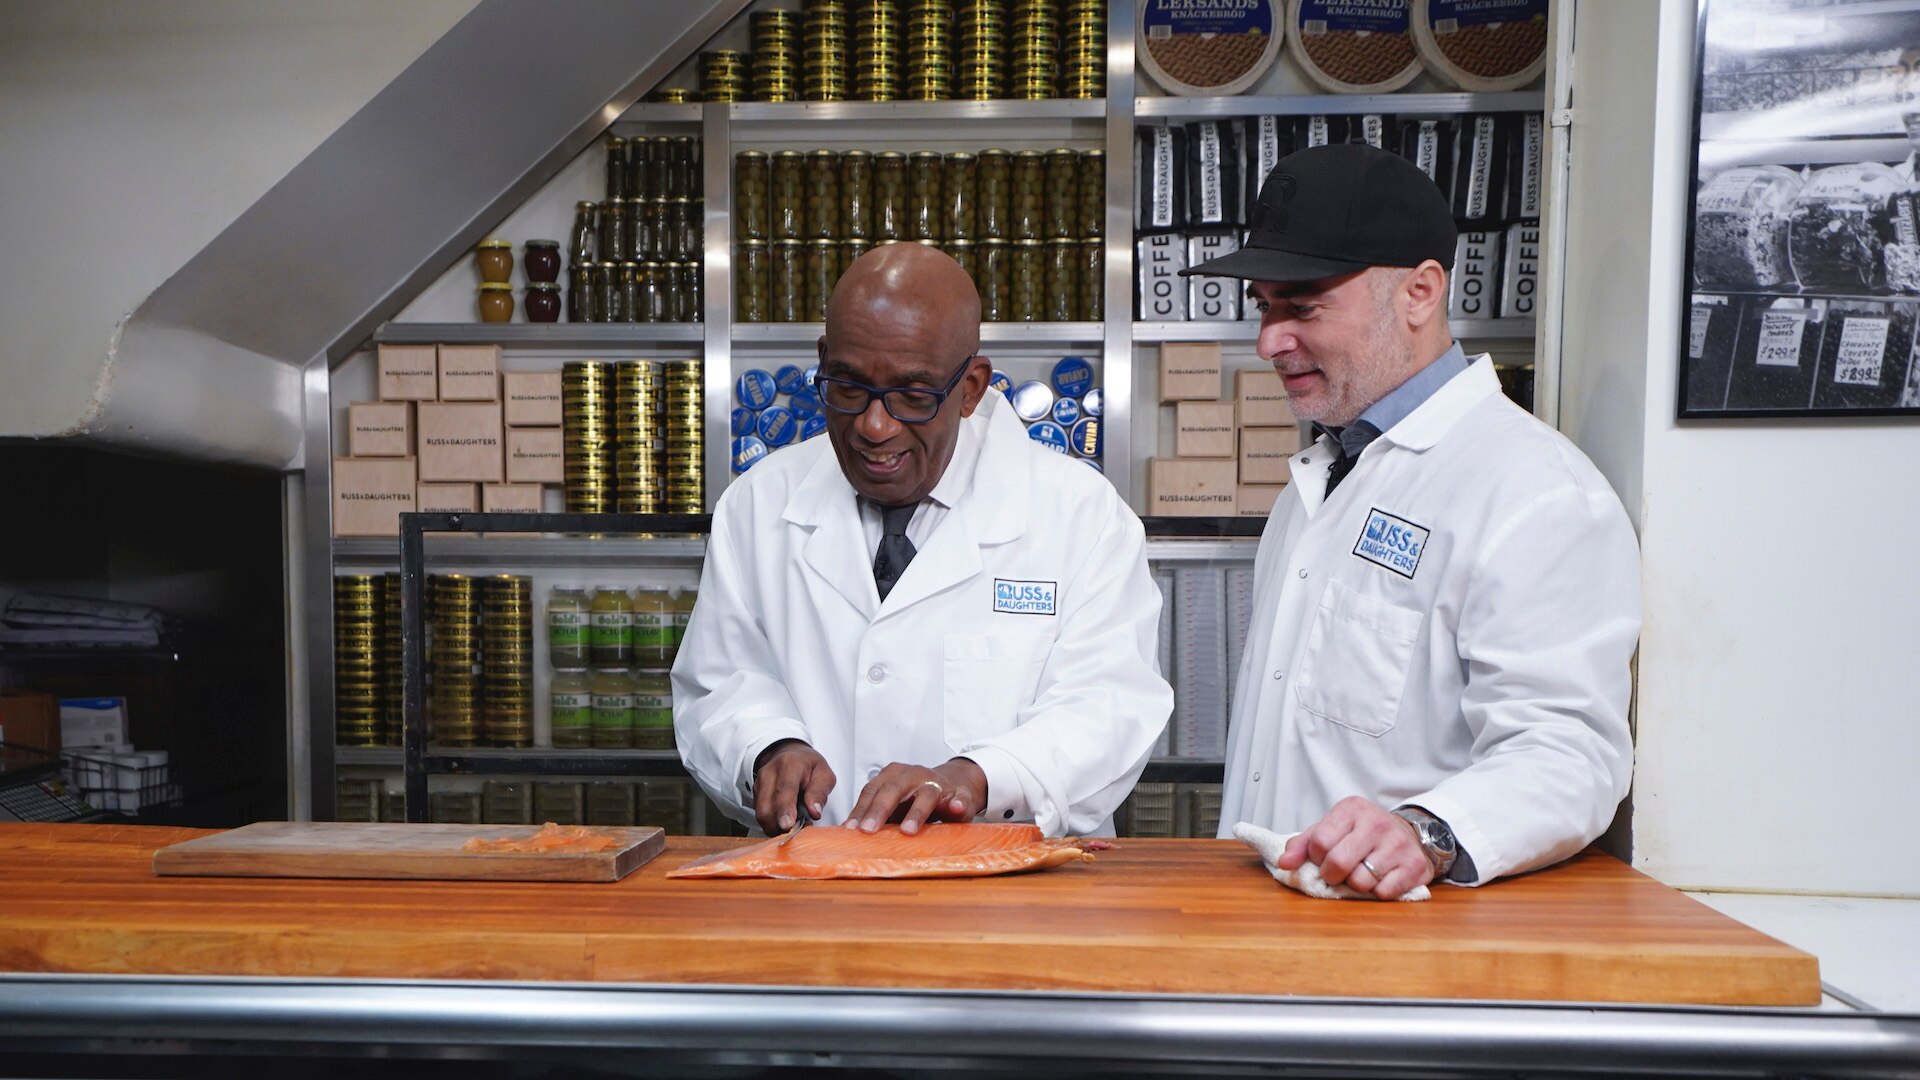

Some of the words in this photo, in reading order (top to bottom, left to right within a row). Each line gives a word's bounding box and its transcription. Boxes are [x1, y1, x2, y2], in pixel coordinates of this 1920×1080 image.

[1152, 236, 1172, 315] COFFE
[1461, 233, 1486, 314] COFFE
[1084, 421, 1098, 454] CAVIAR
[341, 493, 412, 501] RUSS&DAUGHTERS
[1360, 540, 1415, 571] DAUGHTERS
[997, 600, 1053, 611] DAUGHTERS
